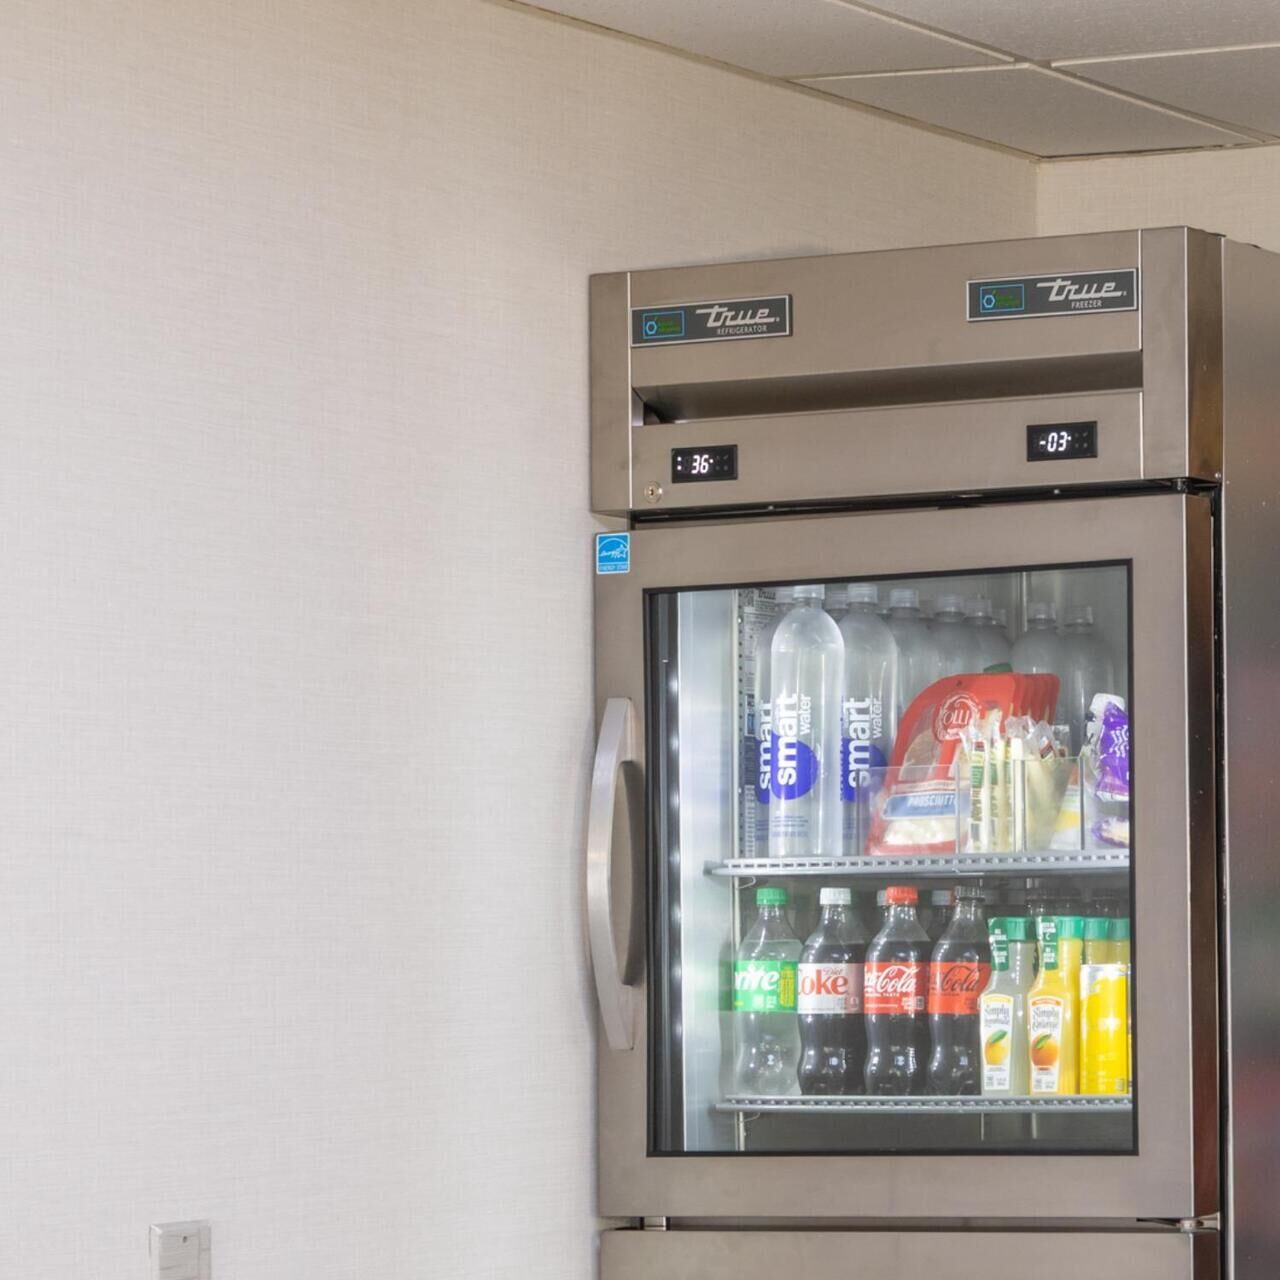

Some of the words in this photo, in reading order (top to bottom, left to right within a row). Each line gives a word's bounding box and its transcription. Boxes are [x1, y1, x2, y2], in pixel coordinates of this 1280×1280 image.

[1071, 300, 1103, 309] FREEZER
[717, 325, 768, 335] REFRIGERATOR
[691, 455, 709, 474] 36
[798, 694, 811, 735] water
[871, 697, 883, 739] water
[777, 693, 798, 786] smart
[844, 697, 870, 788] smart
